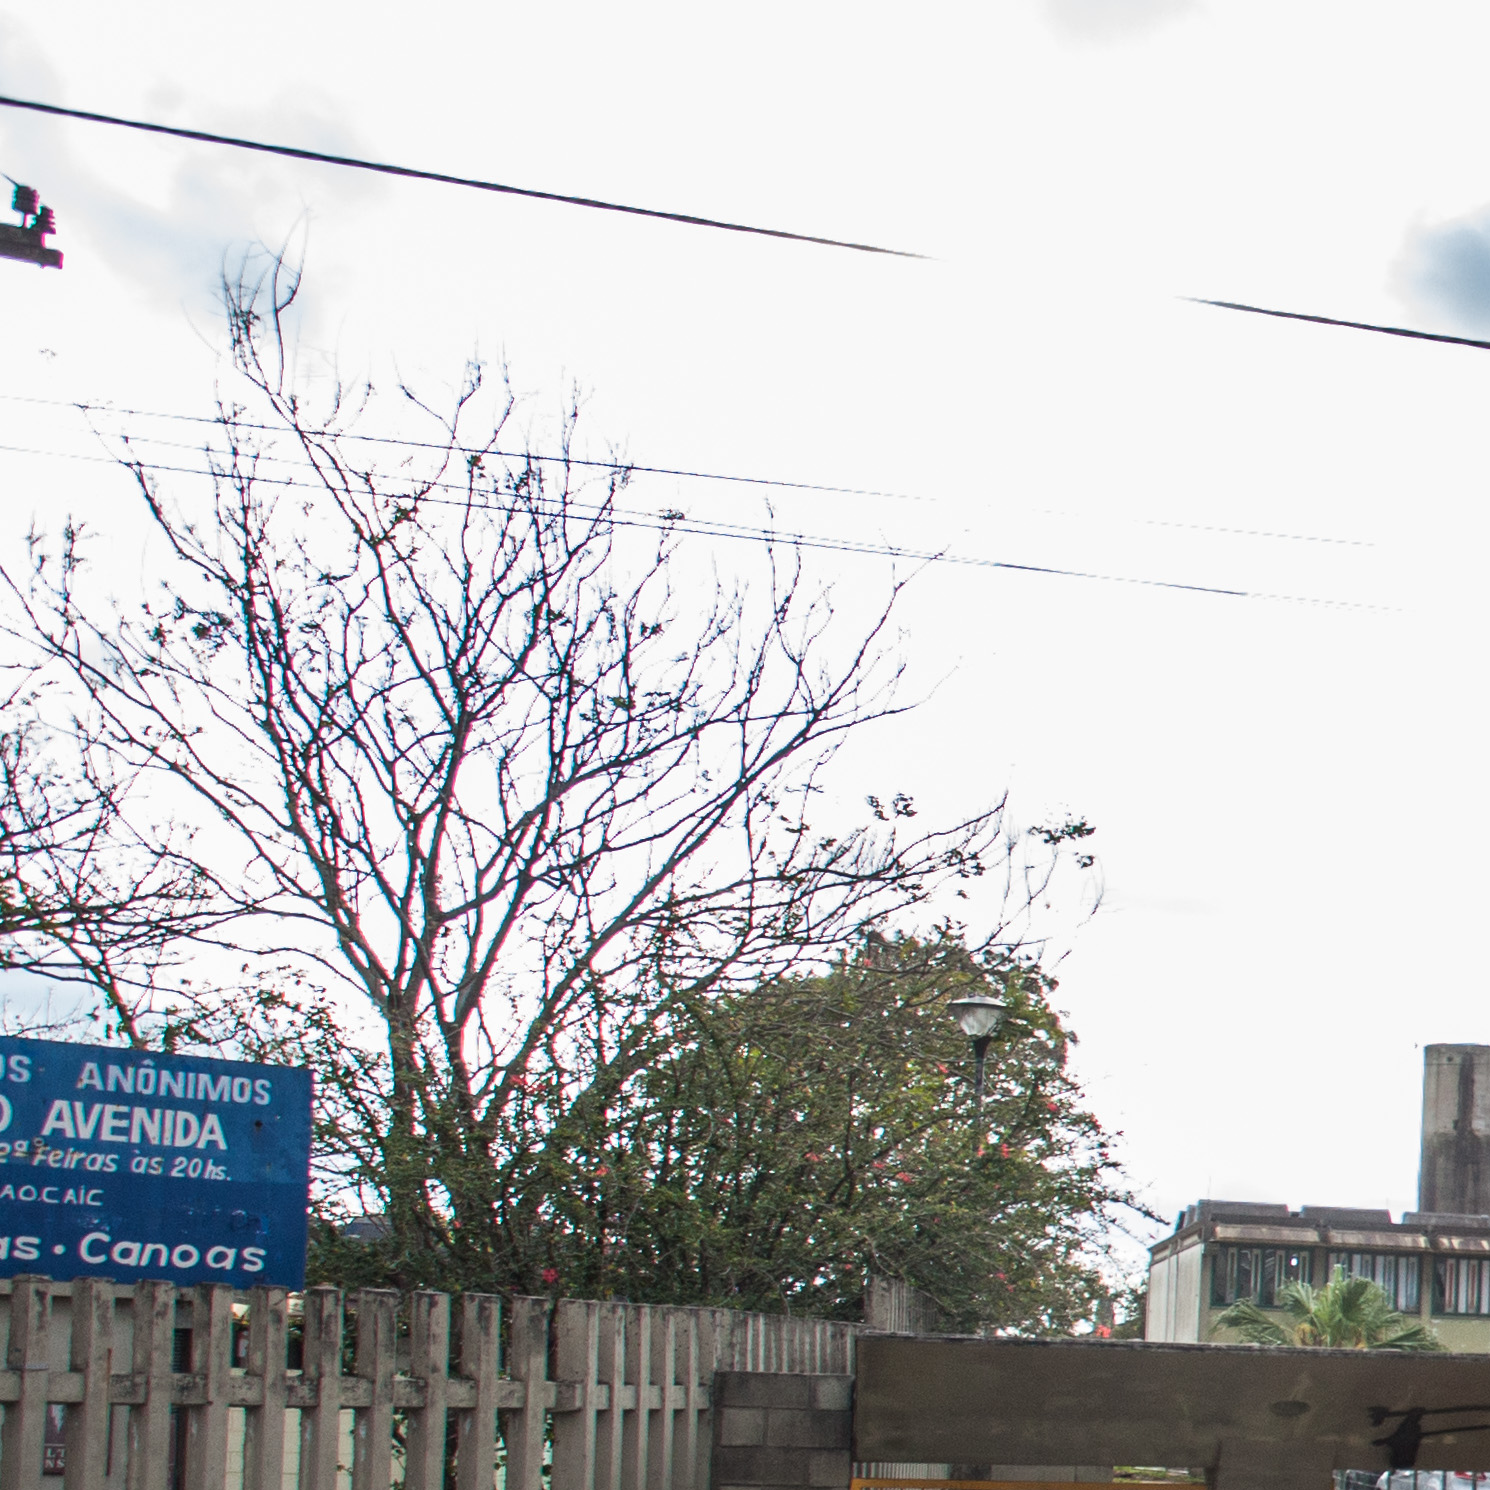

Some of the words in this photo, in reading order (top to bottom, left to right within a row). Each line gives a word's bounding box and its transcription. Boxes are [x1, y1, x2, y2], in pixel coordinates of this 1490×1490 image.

[76, 1059, 272, 1106] ANÔNIMOS
[41, 1099, 228, 1150] AVENIDA
[80, 1231, 267, 1272] Canoas
